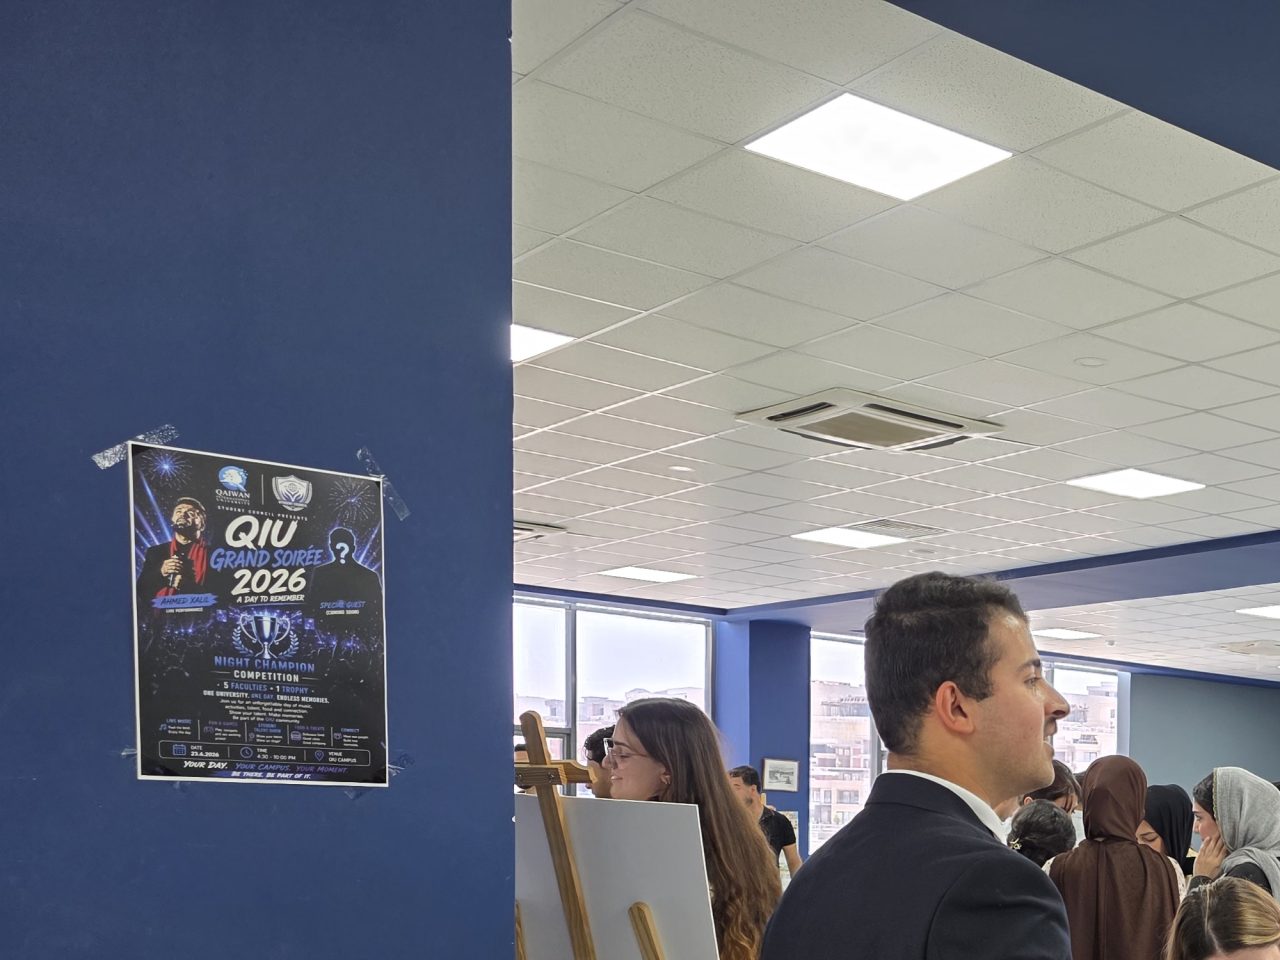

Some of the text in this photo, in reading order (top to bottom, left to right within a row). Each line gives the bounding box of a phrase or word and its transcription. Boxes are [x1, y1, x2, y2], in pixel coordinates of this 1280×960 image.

[215, 489, 250, 499] QAIWAN
[217, 505, 308, 521] STUDENT COUNCIL PRESENTS
[225, 515, 298, 550] QIU
[209, 545, 324, 572] GRAND SOIRÉE
[231, 568, 307, 596] 2026
[244, 595, 258, 603] DAY
[269, 594, 305, 602] REMEMBER
[320, 601, 345, 609] SPECIAL
[214, 655, 315, 672] NIGHT CHAMPION
[233, 670, 299, 682] COMPETITION
[223, 681, 309, 694] 5 FACULTIES 1 TROPHY
[277, 694, 300, 702] ENDLESS
[301, 696, 330, 704] MEMORIES.
[183, 760, 206, 768] YOUR
[207, 761, 228, 769] DAY.
